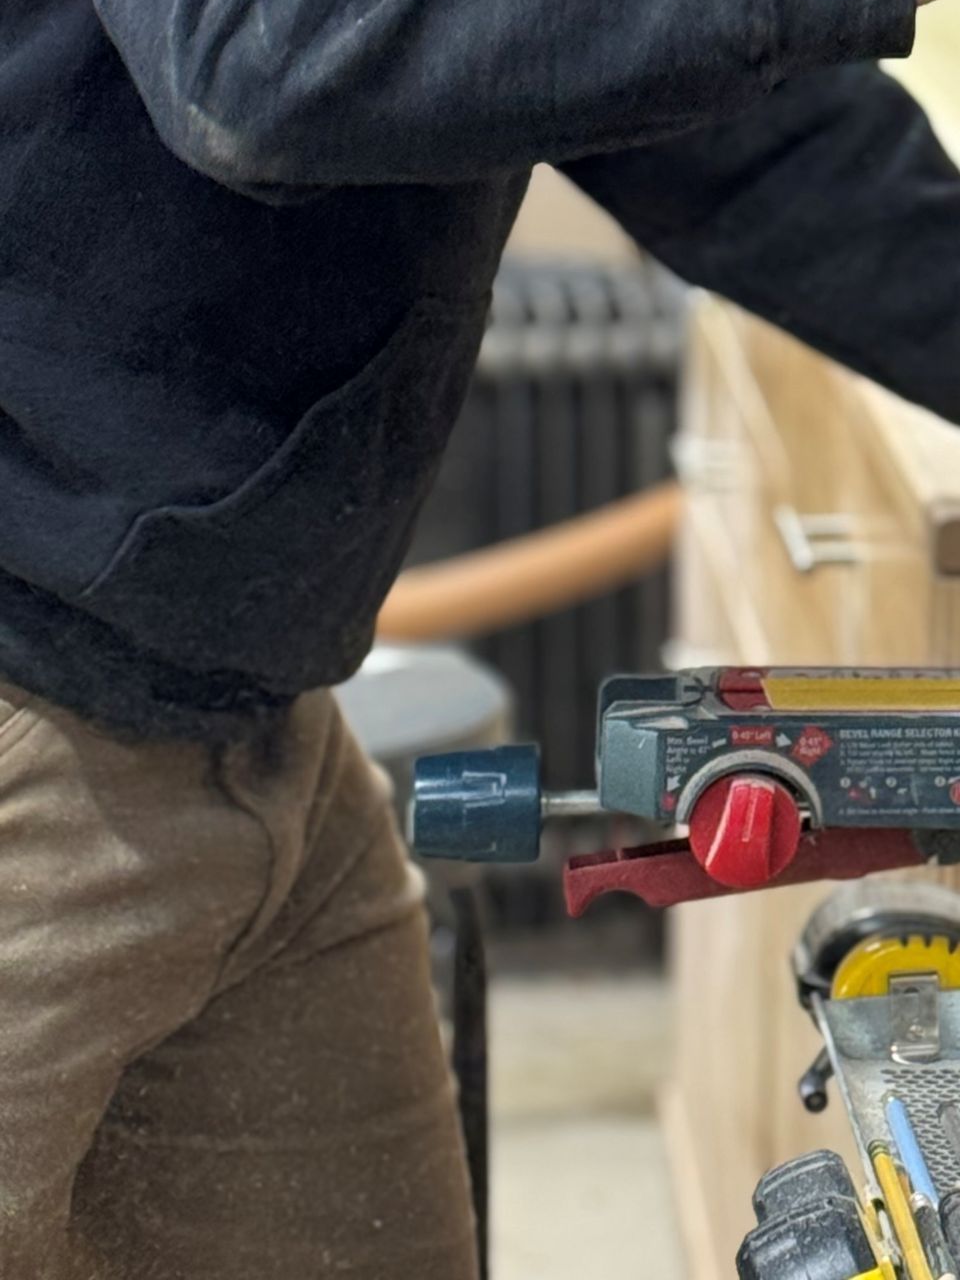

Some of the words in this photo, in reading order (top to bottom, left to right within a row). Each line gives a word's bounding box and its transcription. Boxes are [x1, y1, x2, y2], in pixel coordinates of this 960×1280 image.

[839, 729, 869, 739] BEVEL
[870, 728, 903, 738] RANGE
[904, 727, 953, 738] SELECTOR
